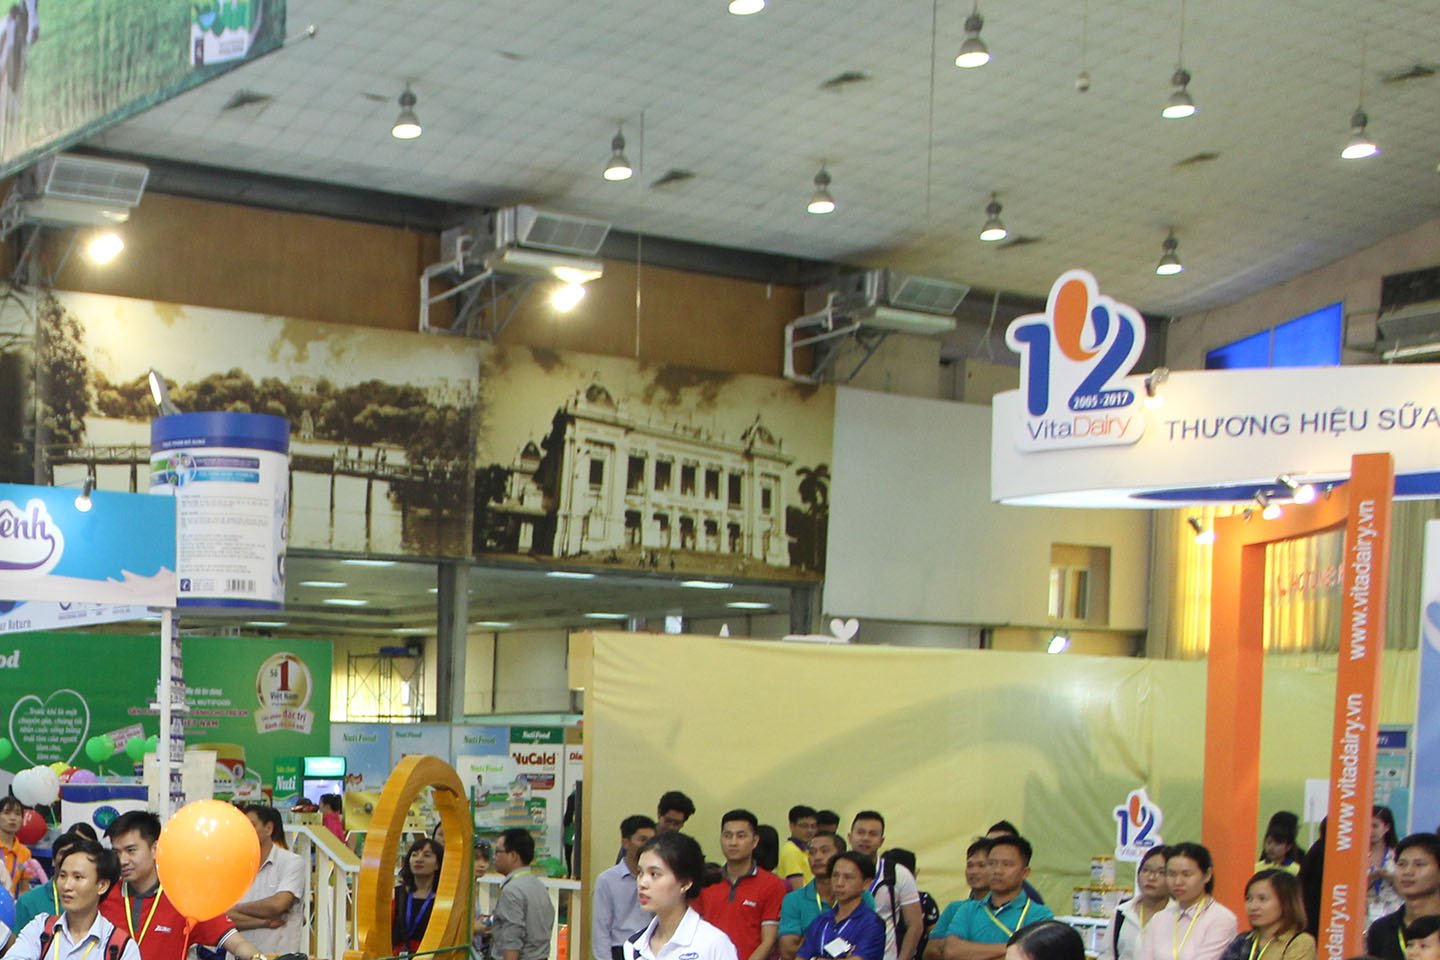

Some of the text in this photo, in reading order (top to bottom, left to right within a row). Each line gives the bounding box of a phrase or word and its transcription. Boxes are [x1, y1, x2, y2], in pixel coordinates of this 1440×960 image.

[1027, 415, 1132, 440] VitaDairy
[1165, 414, 1290, 440] THƯƠNG
[1300, 407, 1368, 437] HIỆU
[1350, 499, 1375, 662] www.vitadairy.vn
[277, 660, 290, 691] 1
